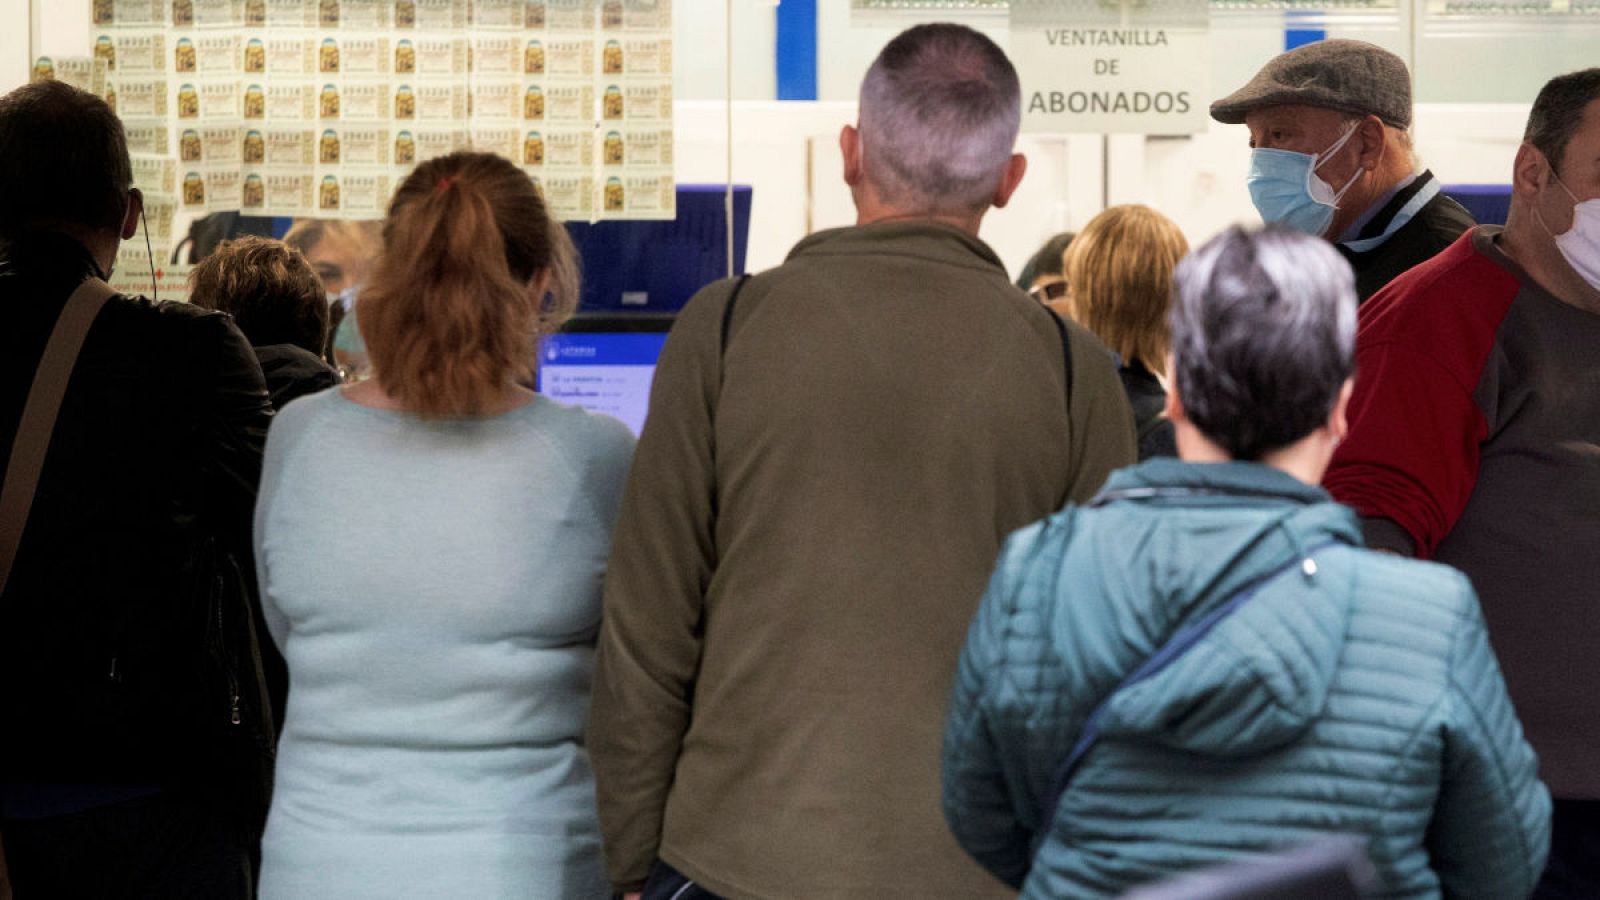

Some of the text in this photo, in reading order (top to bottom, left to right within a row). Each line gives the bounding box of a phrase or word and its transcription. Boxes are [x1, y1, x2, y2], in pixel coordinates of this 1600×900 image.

[1046, 29, 1168, 46] VENTANILLA
[1094, 59, 1120, 76] DE
[1028, 91, 1190, 114] ABONADOS
